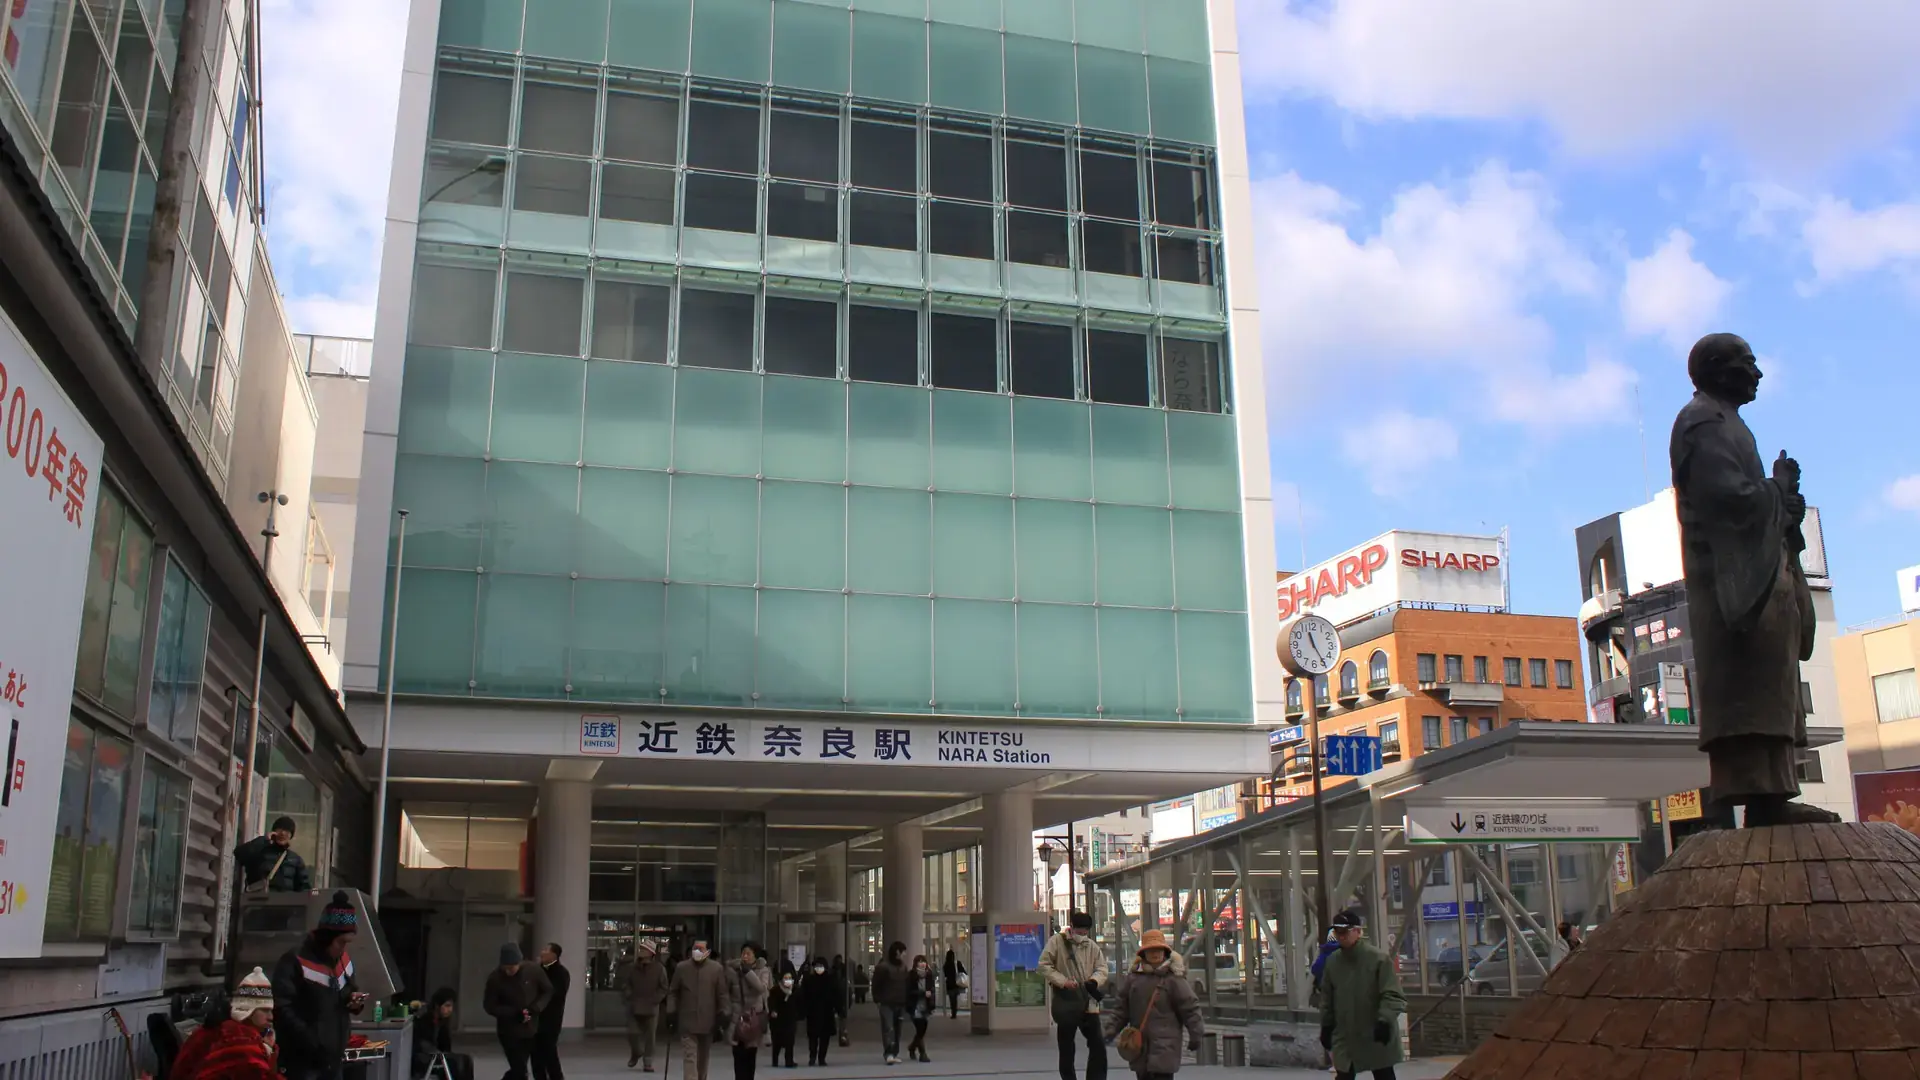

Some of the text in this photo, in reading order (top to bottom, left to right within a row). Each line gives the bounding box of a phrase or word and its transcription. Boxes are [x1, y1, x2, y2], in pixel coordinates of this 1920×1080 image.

[1401, 549, 1500, 572] SHARP
[1278, 544, 1388, 620] SHARP
[0, 663, 27, 708] あと
[584, 722, 616, 738] 近鉄
[938, 730, 1023, 746] KINTETSU
[584, 740, 616, 748] KINTETSU
[638, 720, 912, 760] 近鉄奈良駅
[938, 748, 1050, 764] NARA Station
[13, 759, 26, 792] 日
[1492, 813, 1548, 825] 近鉄線のりば
